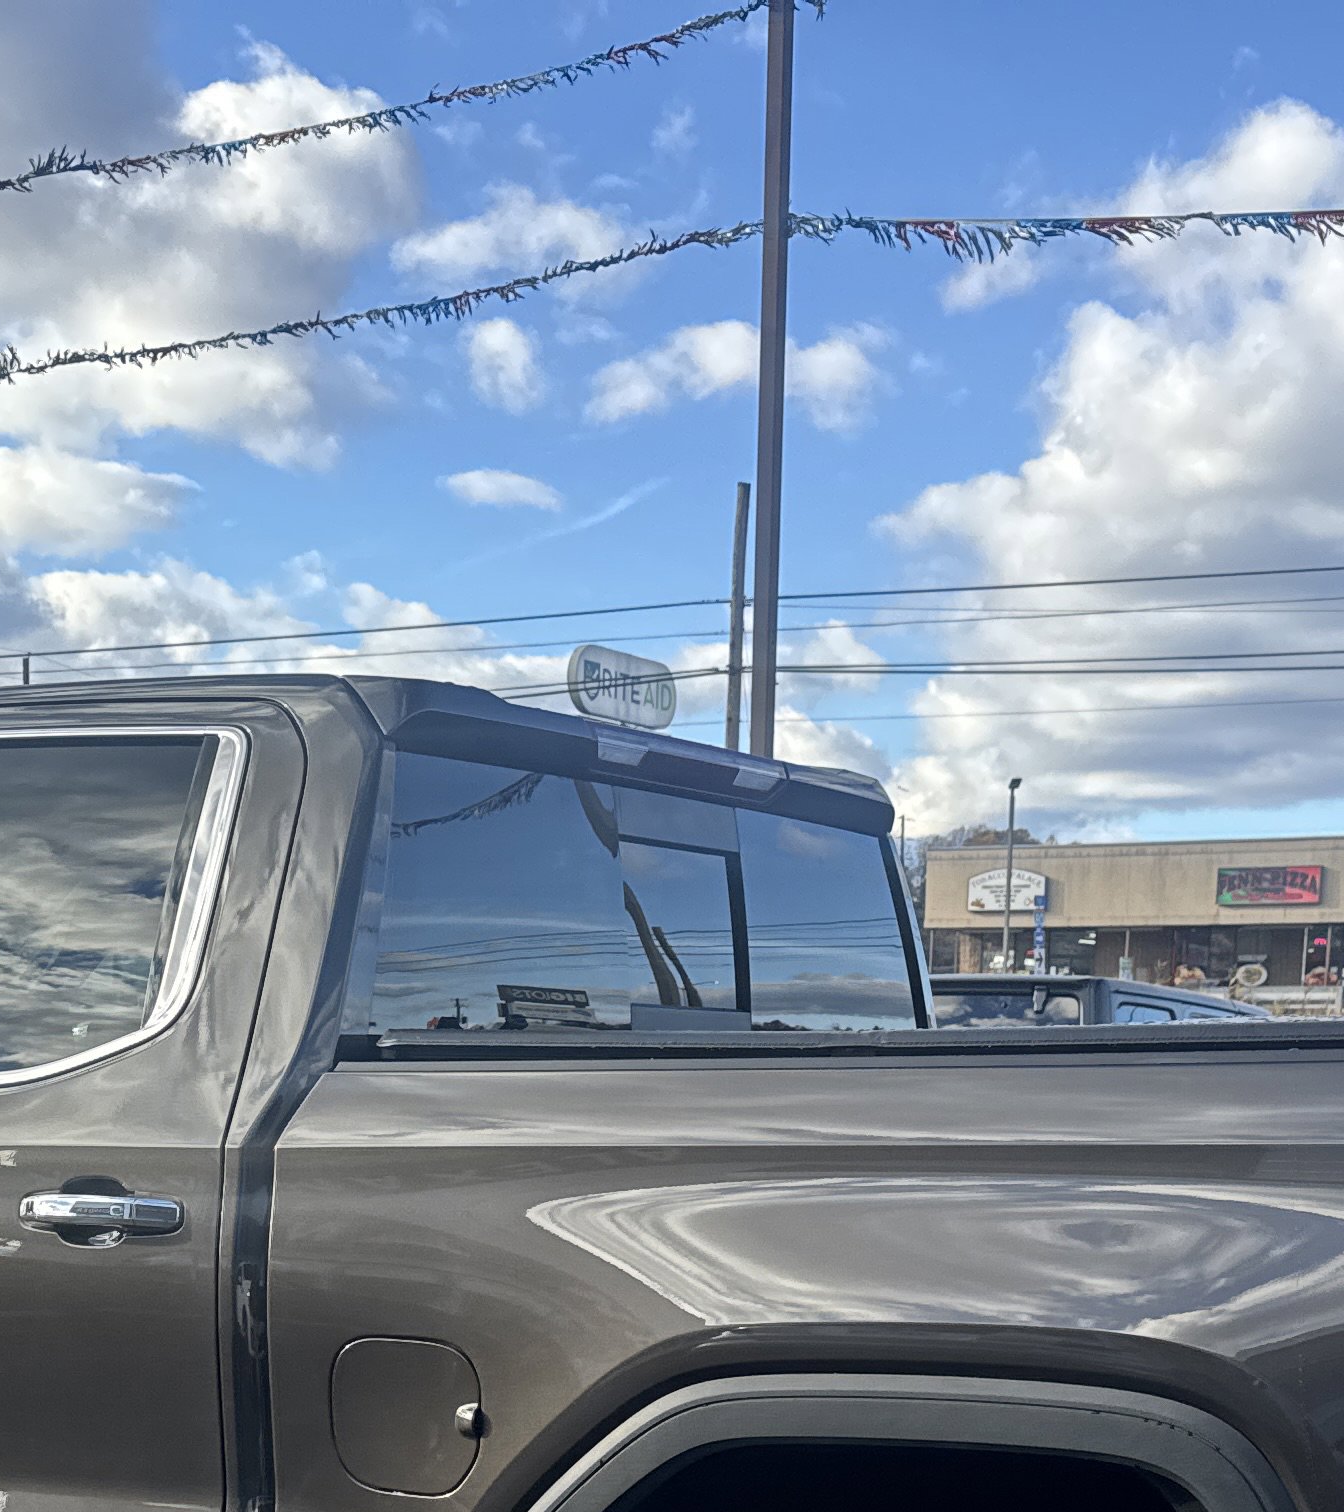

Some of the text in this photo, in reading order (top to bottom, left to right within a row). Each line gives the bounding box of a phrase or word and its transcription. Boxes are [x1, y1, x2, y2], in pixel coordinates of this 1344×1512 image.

[602, 667, 672, 711] RITE AID
[1270, 870, 1318, 896] PIZZA
